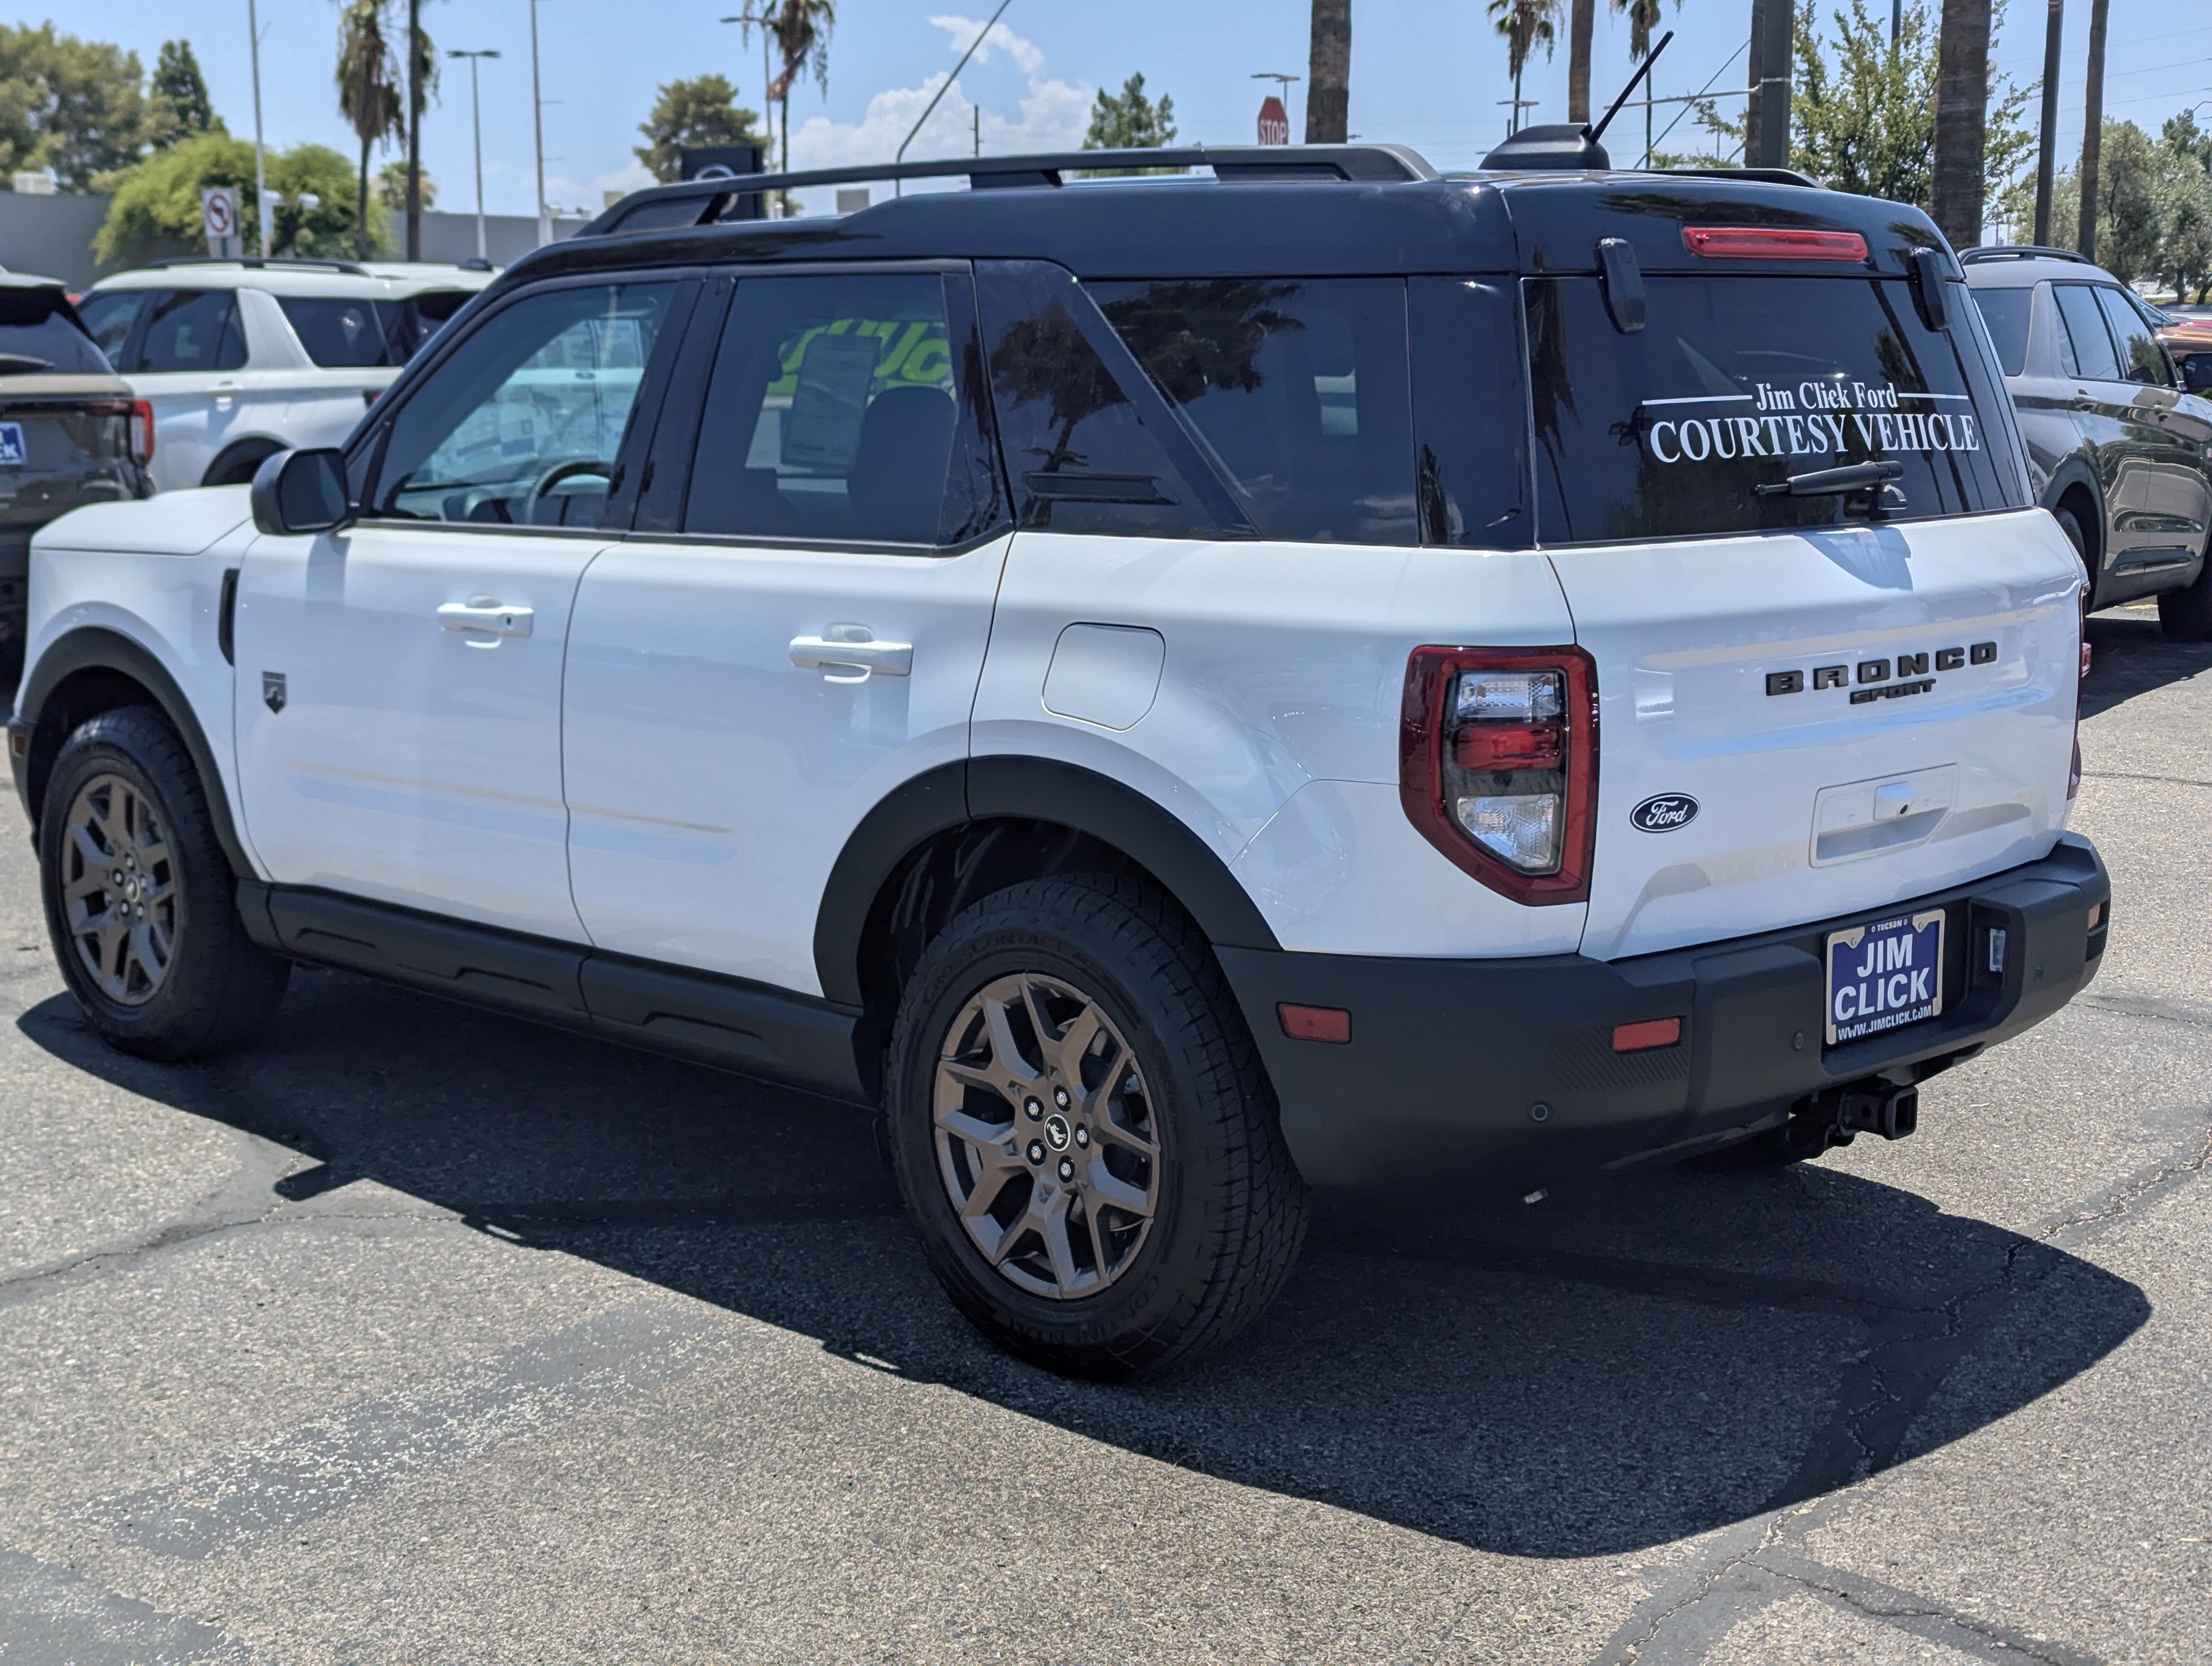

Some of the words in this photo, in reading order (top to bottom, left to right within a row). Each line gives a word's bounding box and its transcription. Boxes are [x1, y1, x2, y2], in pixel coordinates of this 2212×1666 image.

[1259, 119, 1287, 145] STOP
[1755, 382, 1796, 411] Jim
[1798, 381, 1851, 409] Click
[1851, 381, 1899, 408] Ford
[1650, 413, 1849, 464] COURTESY
[1851, 413, 1980, 452] VEHICLE
[1765, 641, 1998, 696] BRONCO
[1849, 678, 1937, 705] SPORT
[1645, 800, 1689, 826] Ford
[1877, 919, 1902, 932] TUCSON
[1856, 933, 1913, 977] JIM
[1835, 967, 1930, 1021] CLICK
[1837, 1004, 1932, 1041] WWW.JIMCLICK.COM
